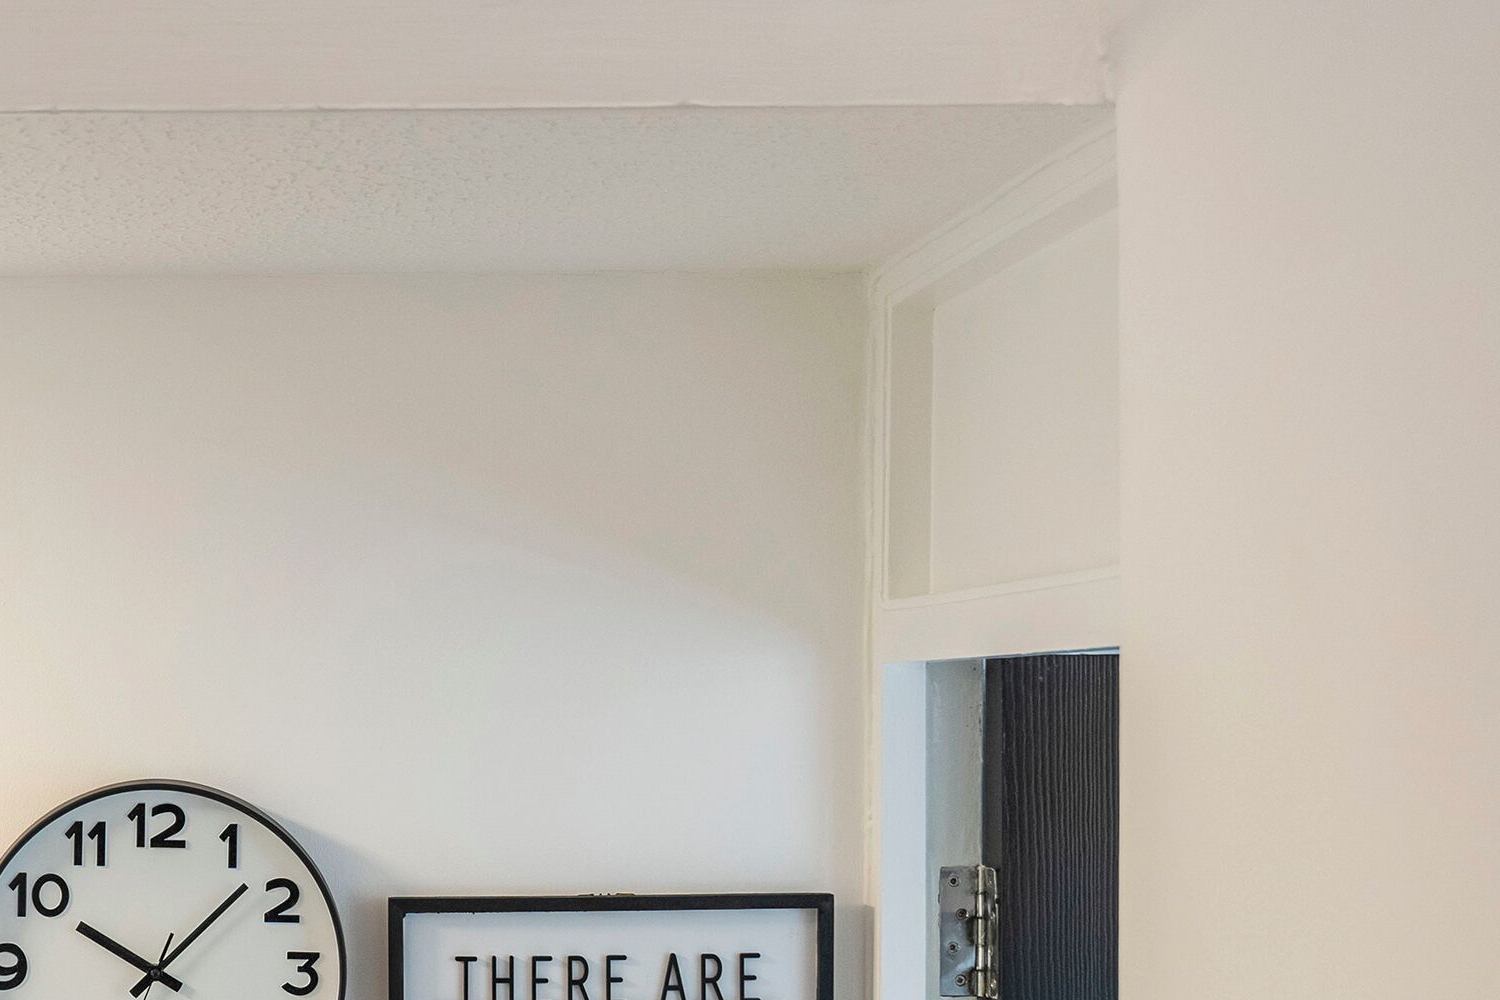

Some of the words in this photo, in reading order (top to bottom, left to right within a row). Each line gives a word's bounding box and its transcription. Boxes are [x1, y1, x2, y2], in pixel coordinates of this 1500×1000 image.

[64, 821, 106, 866] 11
[127, 803, 186, 848] 12
[219, 824, 238, 869] 1
[8, 872, 70, 918] 10
[264, 878, 300, 923] 2
[281, 952, 320, 996] 3
